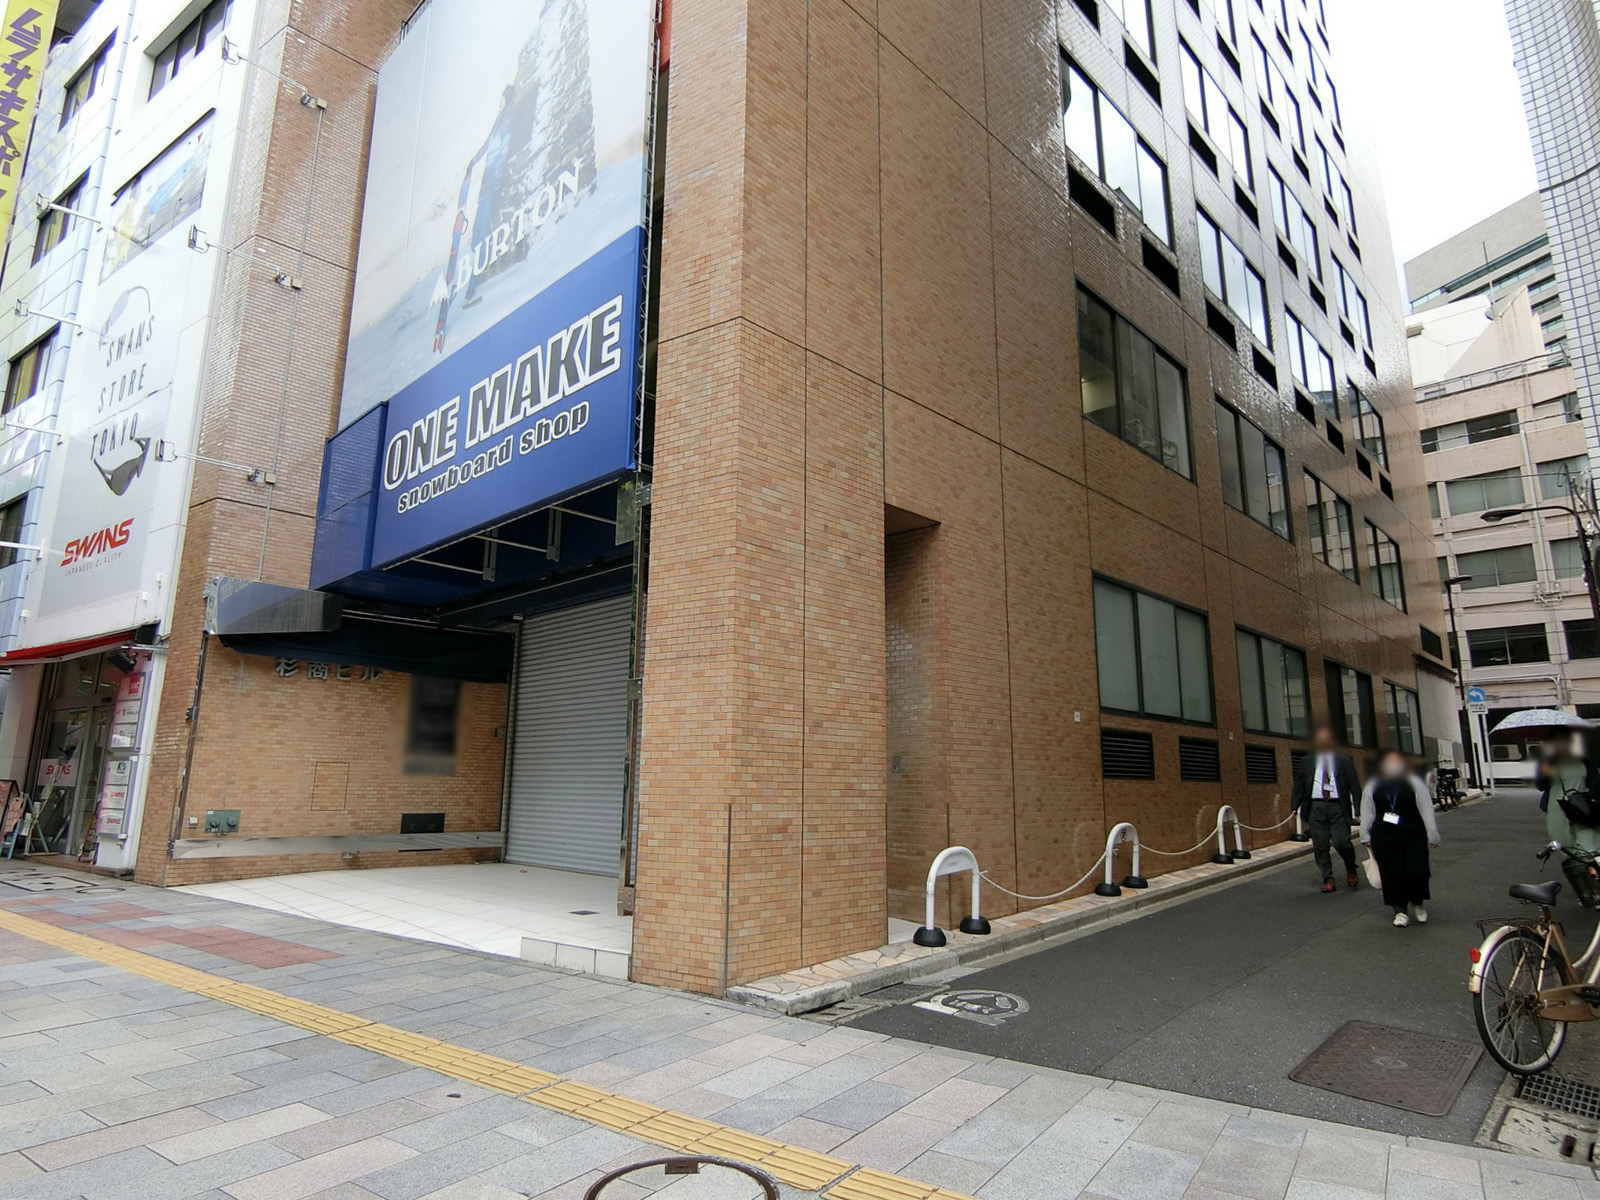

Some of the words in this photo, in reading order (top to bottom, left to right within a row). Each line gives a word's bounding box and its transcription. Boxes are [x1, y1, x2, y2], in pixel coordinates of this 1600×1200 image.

[0, 8, 43, 199] ムラサキスポ
[453, 156, 584, 294] BURTON
[106, 315, 155, 367] SWANS
[98, 363, 147, 414] STORE
[384, 395, 461, 491] ONE
[464, 294, 623, 450] MAKE
[90, 412, 138, 461] TOKYO
[397, 434, 514, 514] snowboard
[519, 400, 590, 455] shop
[59, 516, 135, 567] SWANS
[64, 561, 93, 577] JAPANESE
